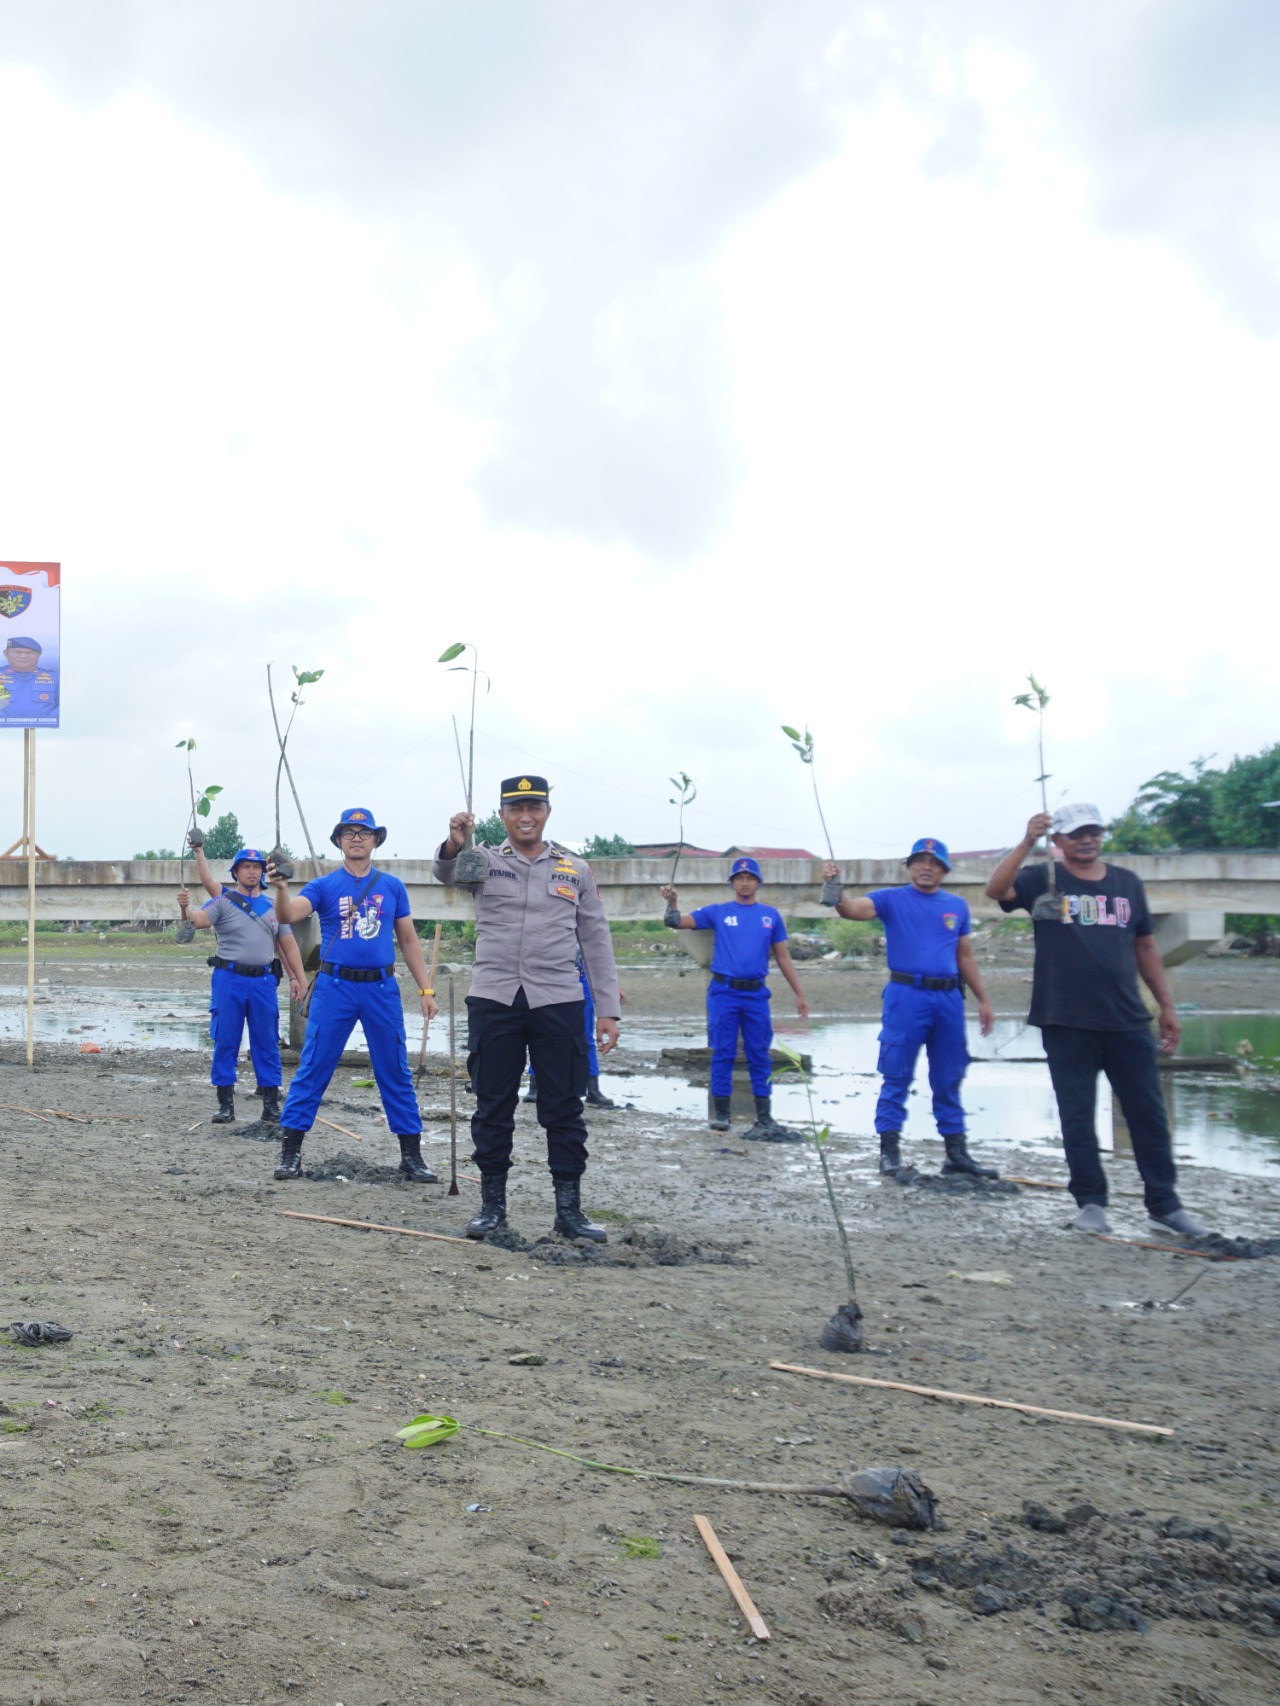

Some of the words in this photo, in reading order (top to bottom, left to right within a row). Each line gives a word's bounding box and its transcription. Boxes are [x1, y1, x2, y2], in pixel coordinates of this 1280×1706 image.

[552, 873, 580, 887] POLRI
[1062, 894, 1131, 928] POLO
[724, 916, 738, 926] 41
